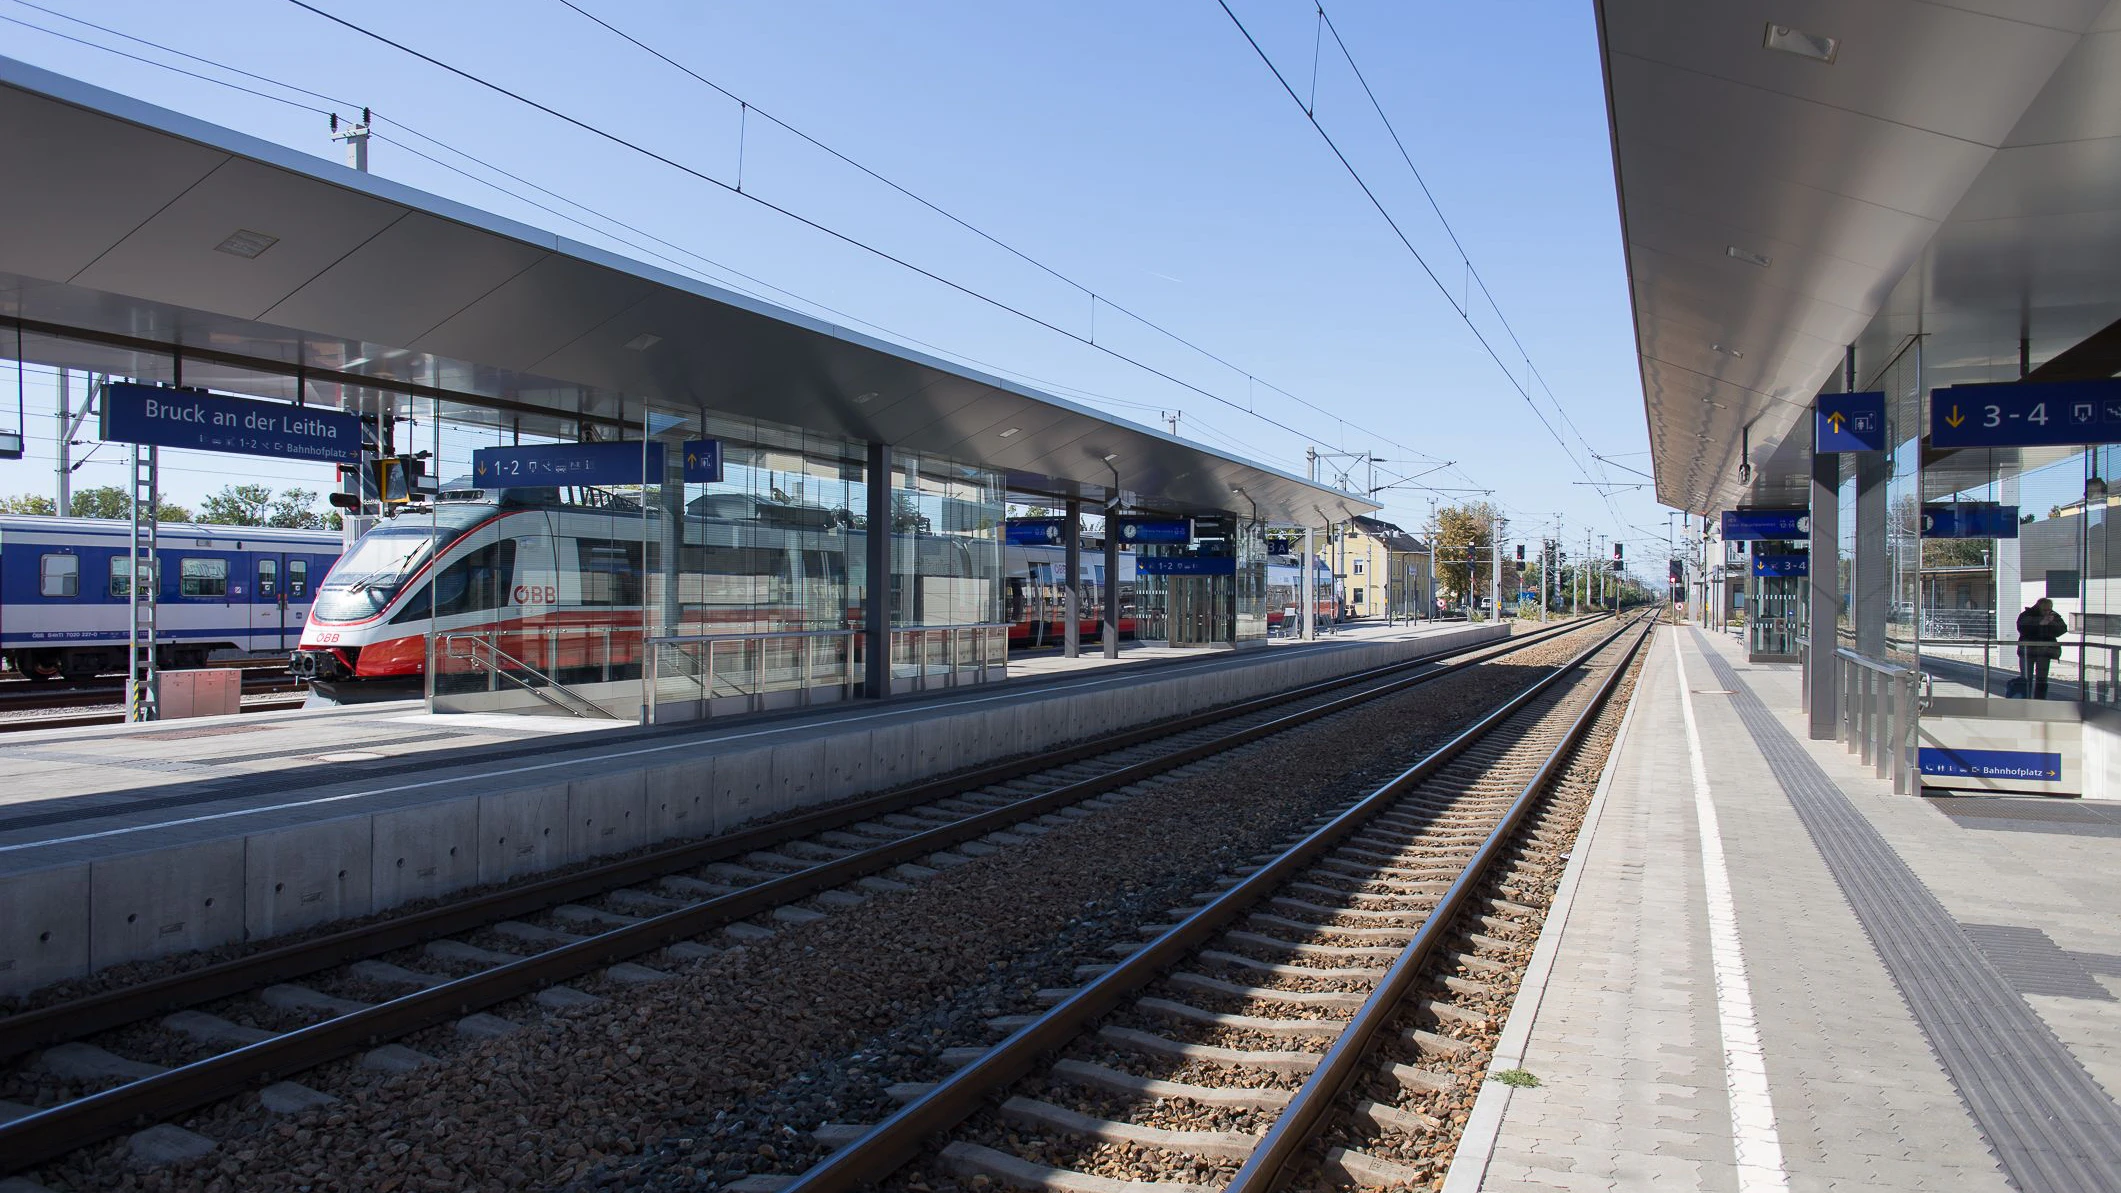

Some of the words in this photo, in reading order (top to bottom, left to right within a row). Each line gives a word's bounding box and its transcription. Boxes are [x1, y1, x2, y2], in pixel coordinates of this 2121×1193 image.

[146, 399, 205, 424] Bruck
[213, 409, 237, 427] an
[244, 411, 276, 431] der
[283, 416, 337, 439] Leitha
[287, 443, 346, 459] Bahnhofplatz
[494, 460, 520, 476] 1-2
[1159, 562, 1173, 570] 1-2
[1983, 766, 2043, 778] Bahnhofplatz
